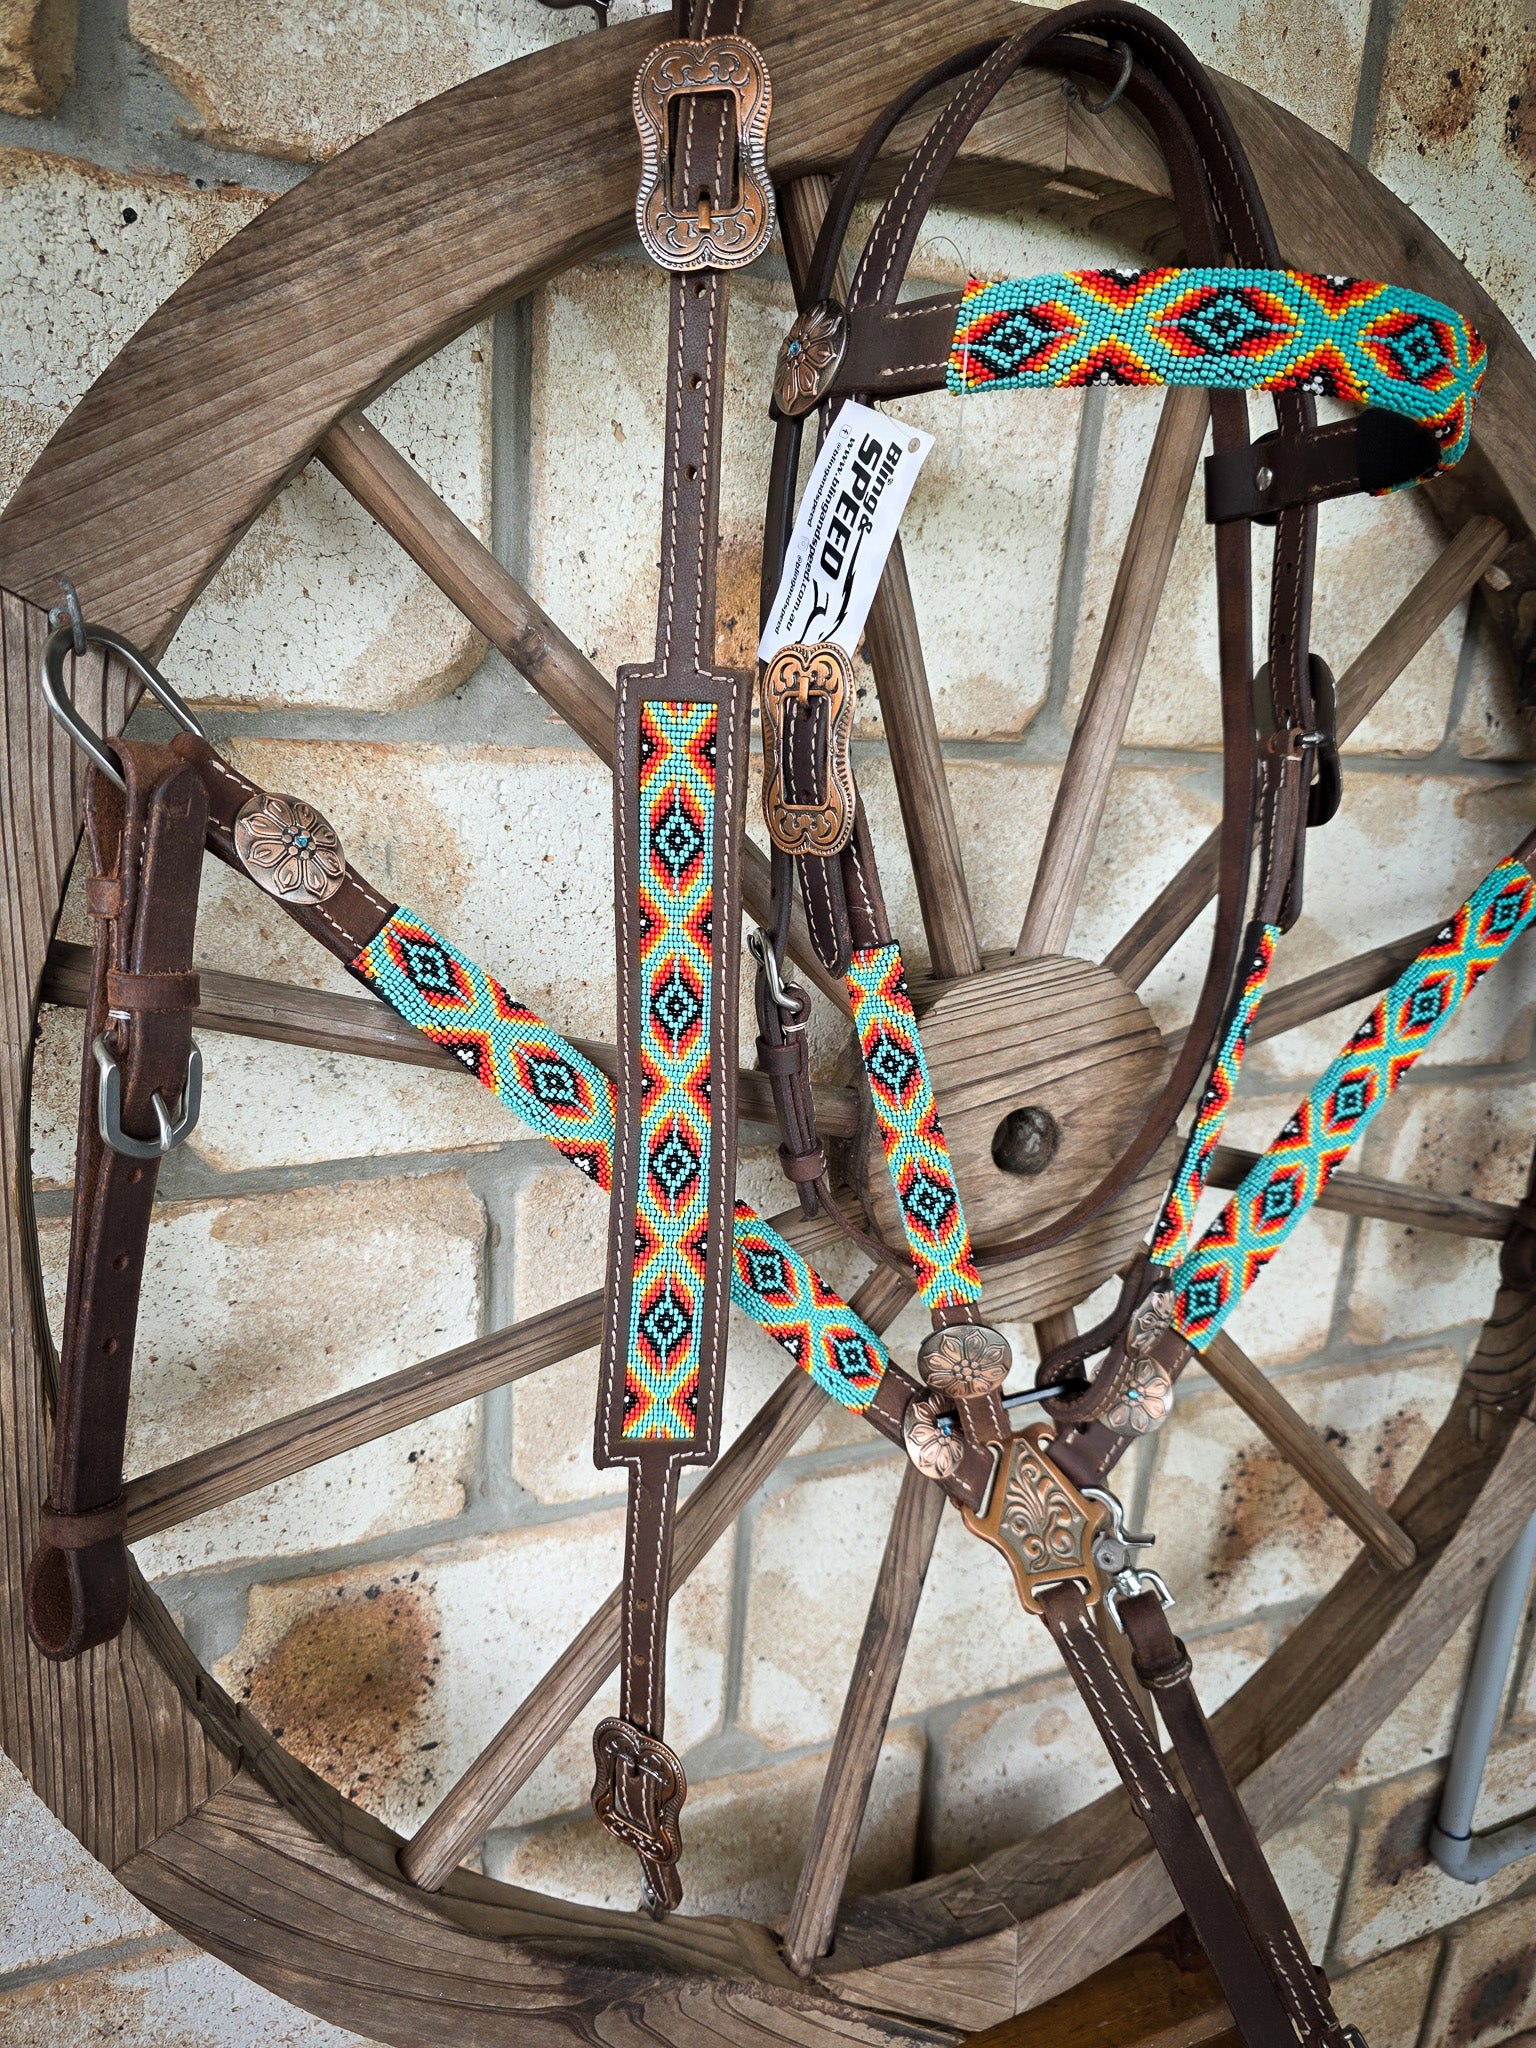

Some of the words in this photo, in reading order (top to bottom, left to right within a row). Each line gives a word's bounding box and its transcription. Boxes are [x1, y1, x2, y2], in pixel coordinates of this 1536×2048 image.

[786, 437, 856, 631] www.blingandspeed.com.au
[807, 442, 841, 528] @blingandspeed
[820, 432, 883, 580] SPEED
[774, 555, 802, 635] @blingandspeed
